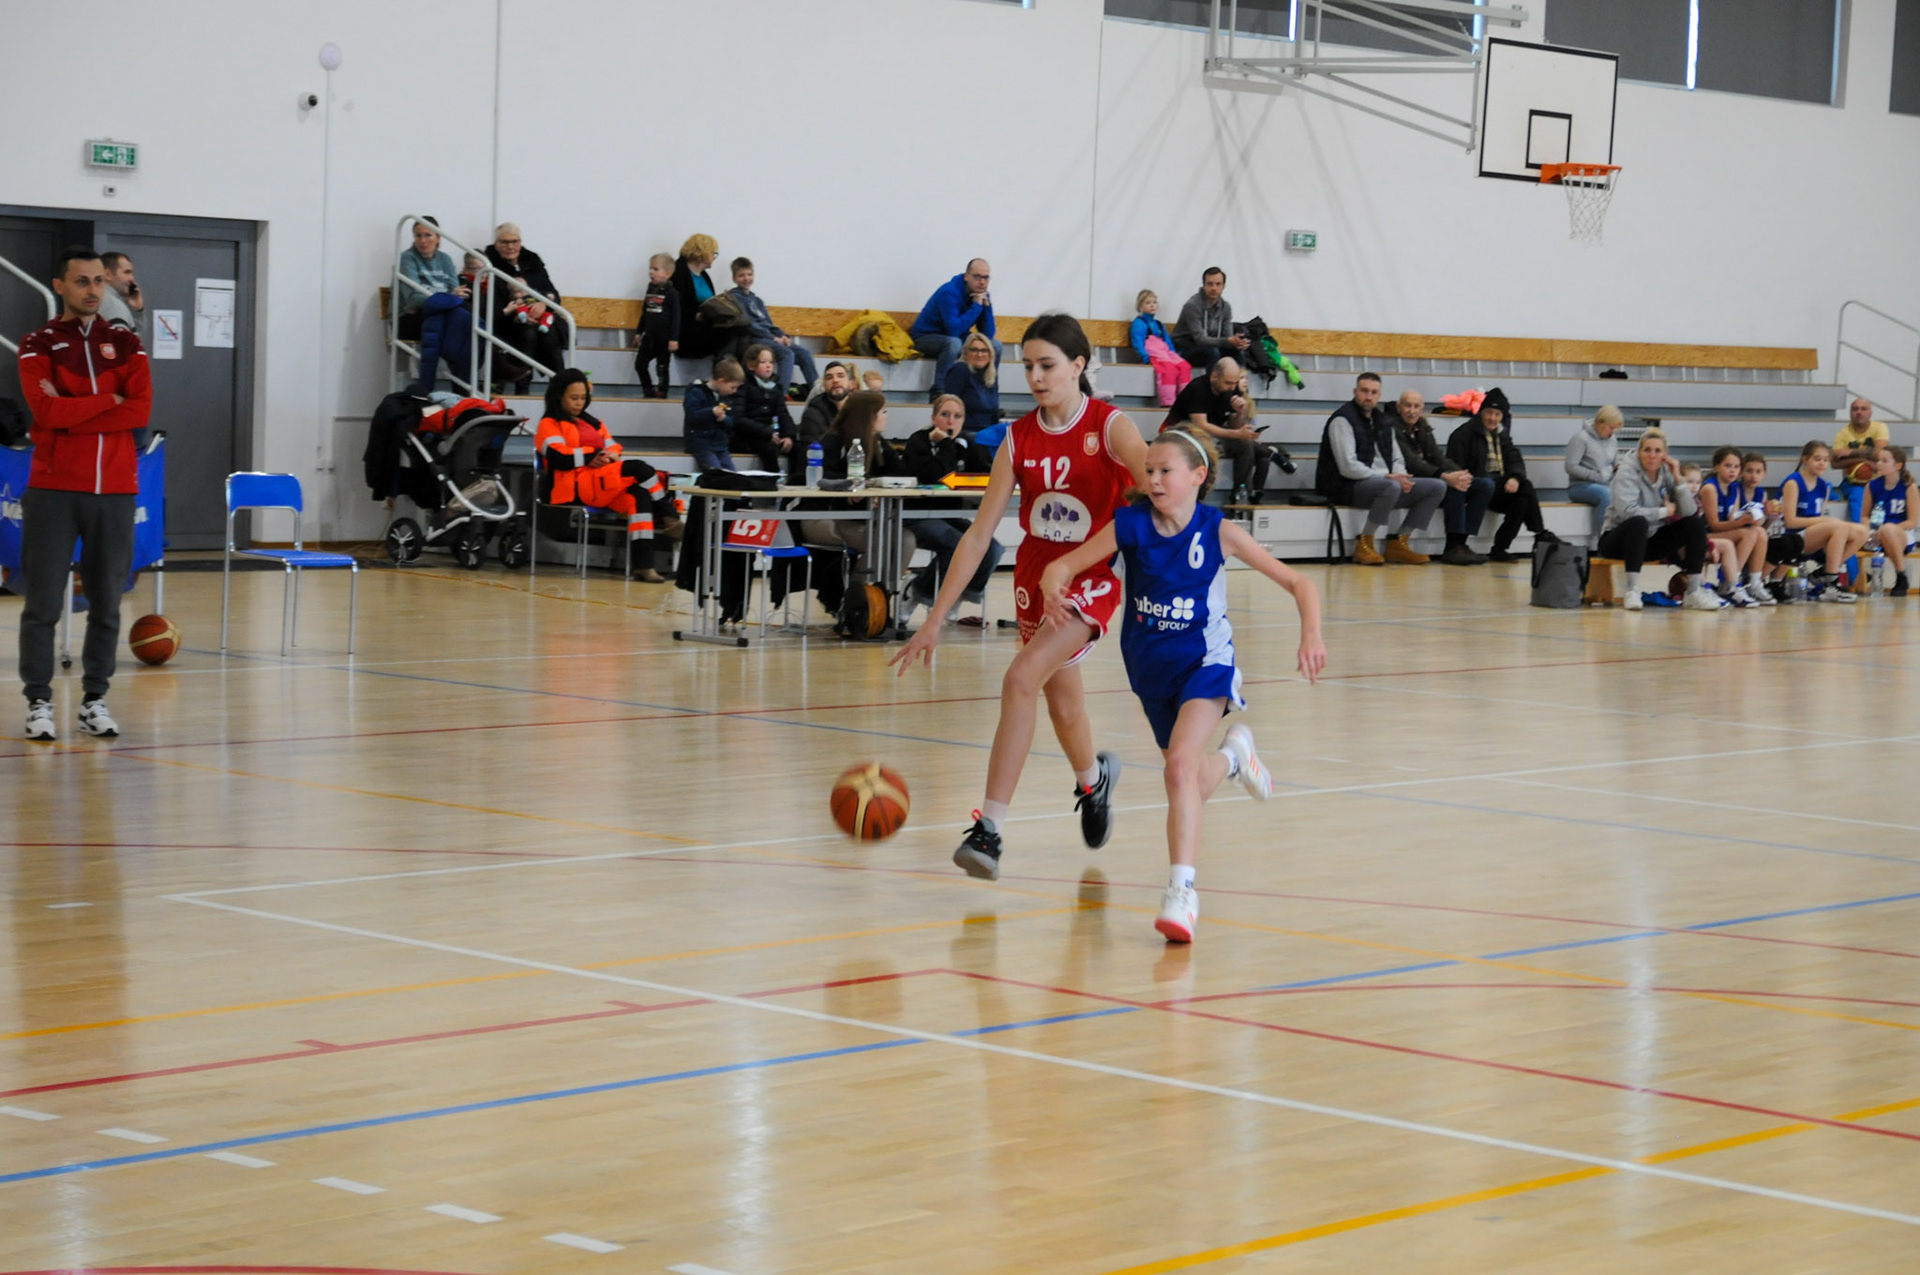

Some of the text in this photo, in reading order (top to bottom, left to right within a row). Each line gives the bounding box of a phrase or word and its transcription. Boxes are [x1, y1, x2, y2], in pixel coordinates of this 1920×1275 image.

[1040, 456, 1070, 490] 12
[1891, 499, 1905, 514] 12
[732, 519, 762, 537] 5
[1188, 532, 1205, 569] 6
[1134, 596, 1172, 618] uber
